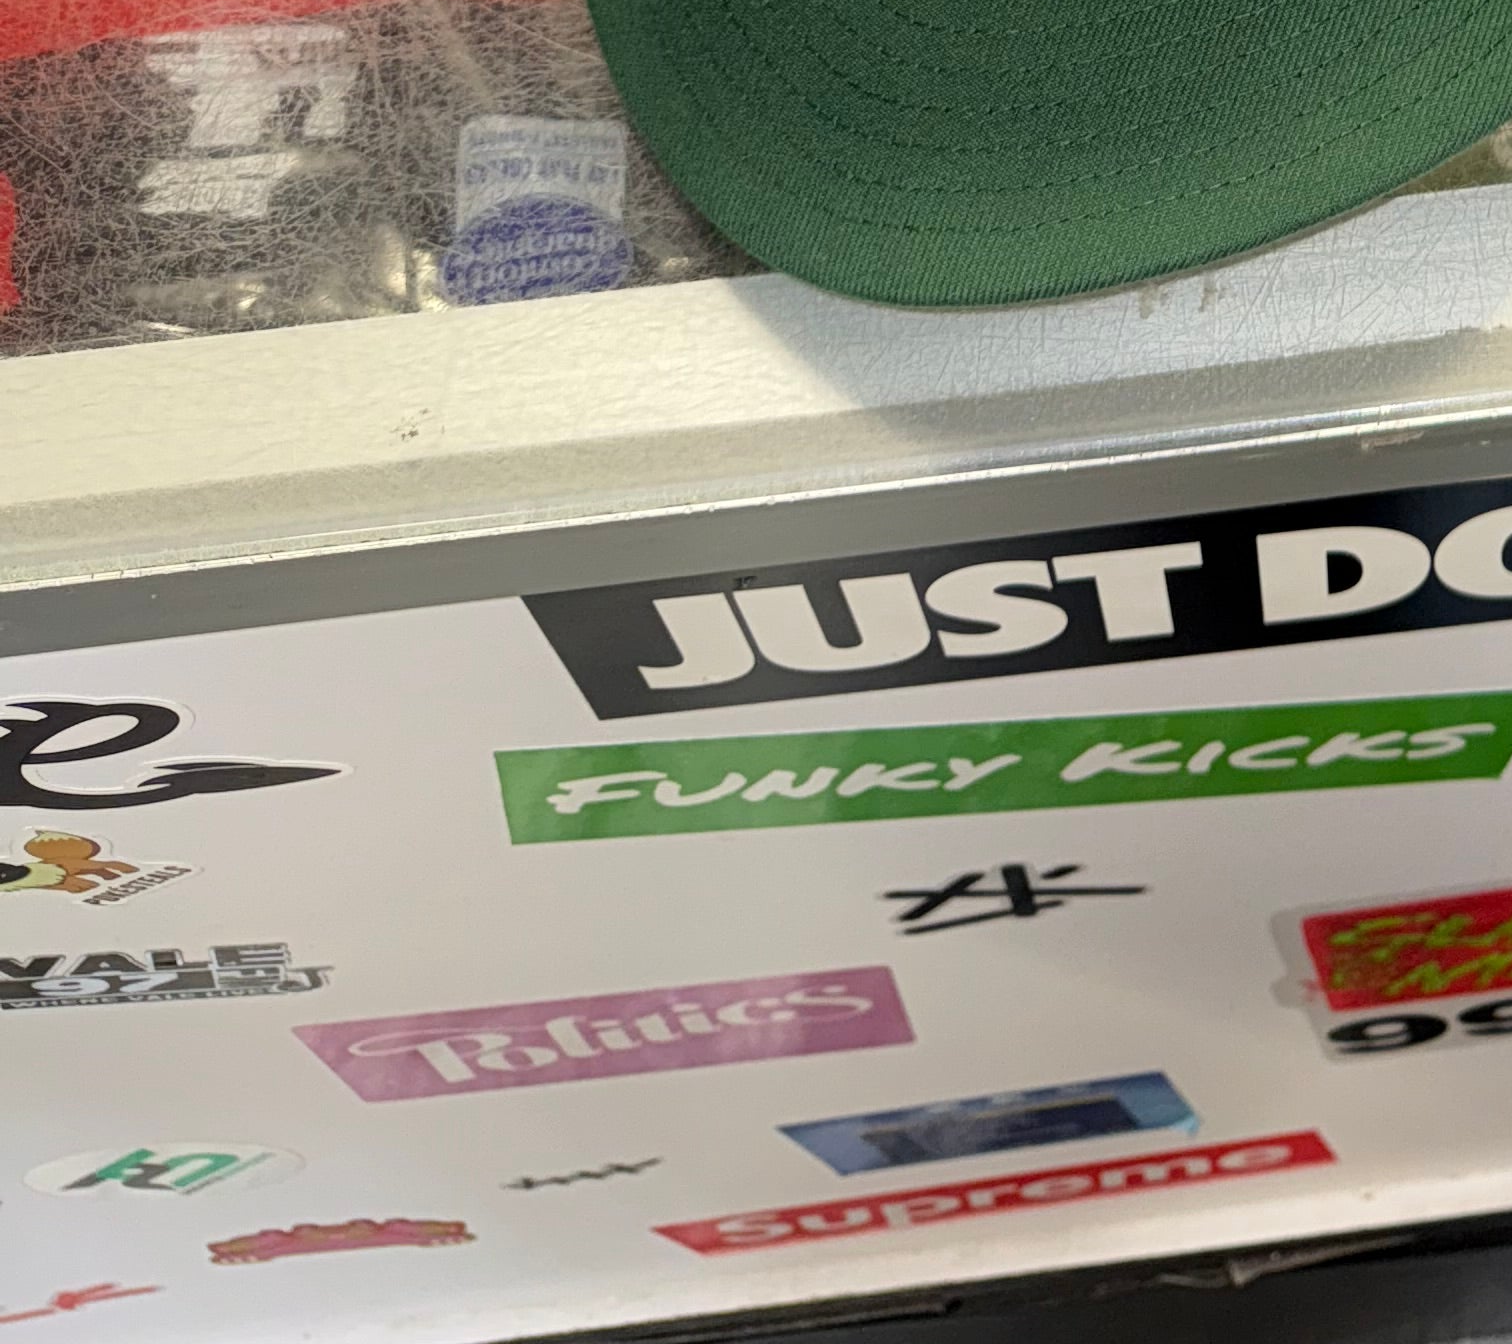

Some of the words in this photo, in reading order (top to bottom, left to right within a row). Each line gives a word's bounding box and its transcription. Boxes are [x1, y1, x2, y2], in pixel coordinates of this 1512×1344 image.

[637, 541, 1204, 690] JUST
[547, 753, 1022, 813] FUNKY
[1058, 722, 1496, 783] KICKS
[9, 993, 120, 1009] WHERE
[31, 972, 180, 997] 97
[348, 980, 876, 1085] Politics
[712, 1136, 1296, 1247] Supreme
